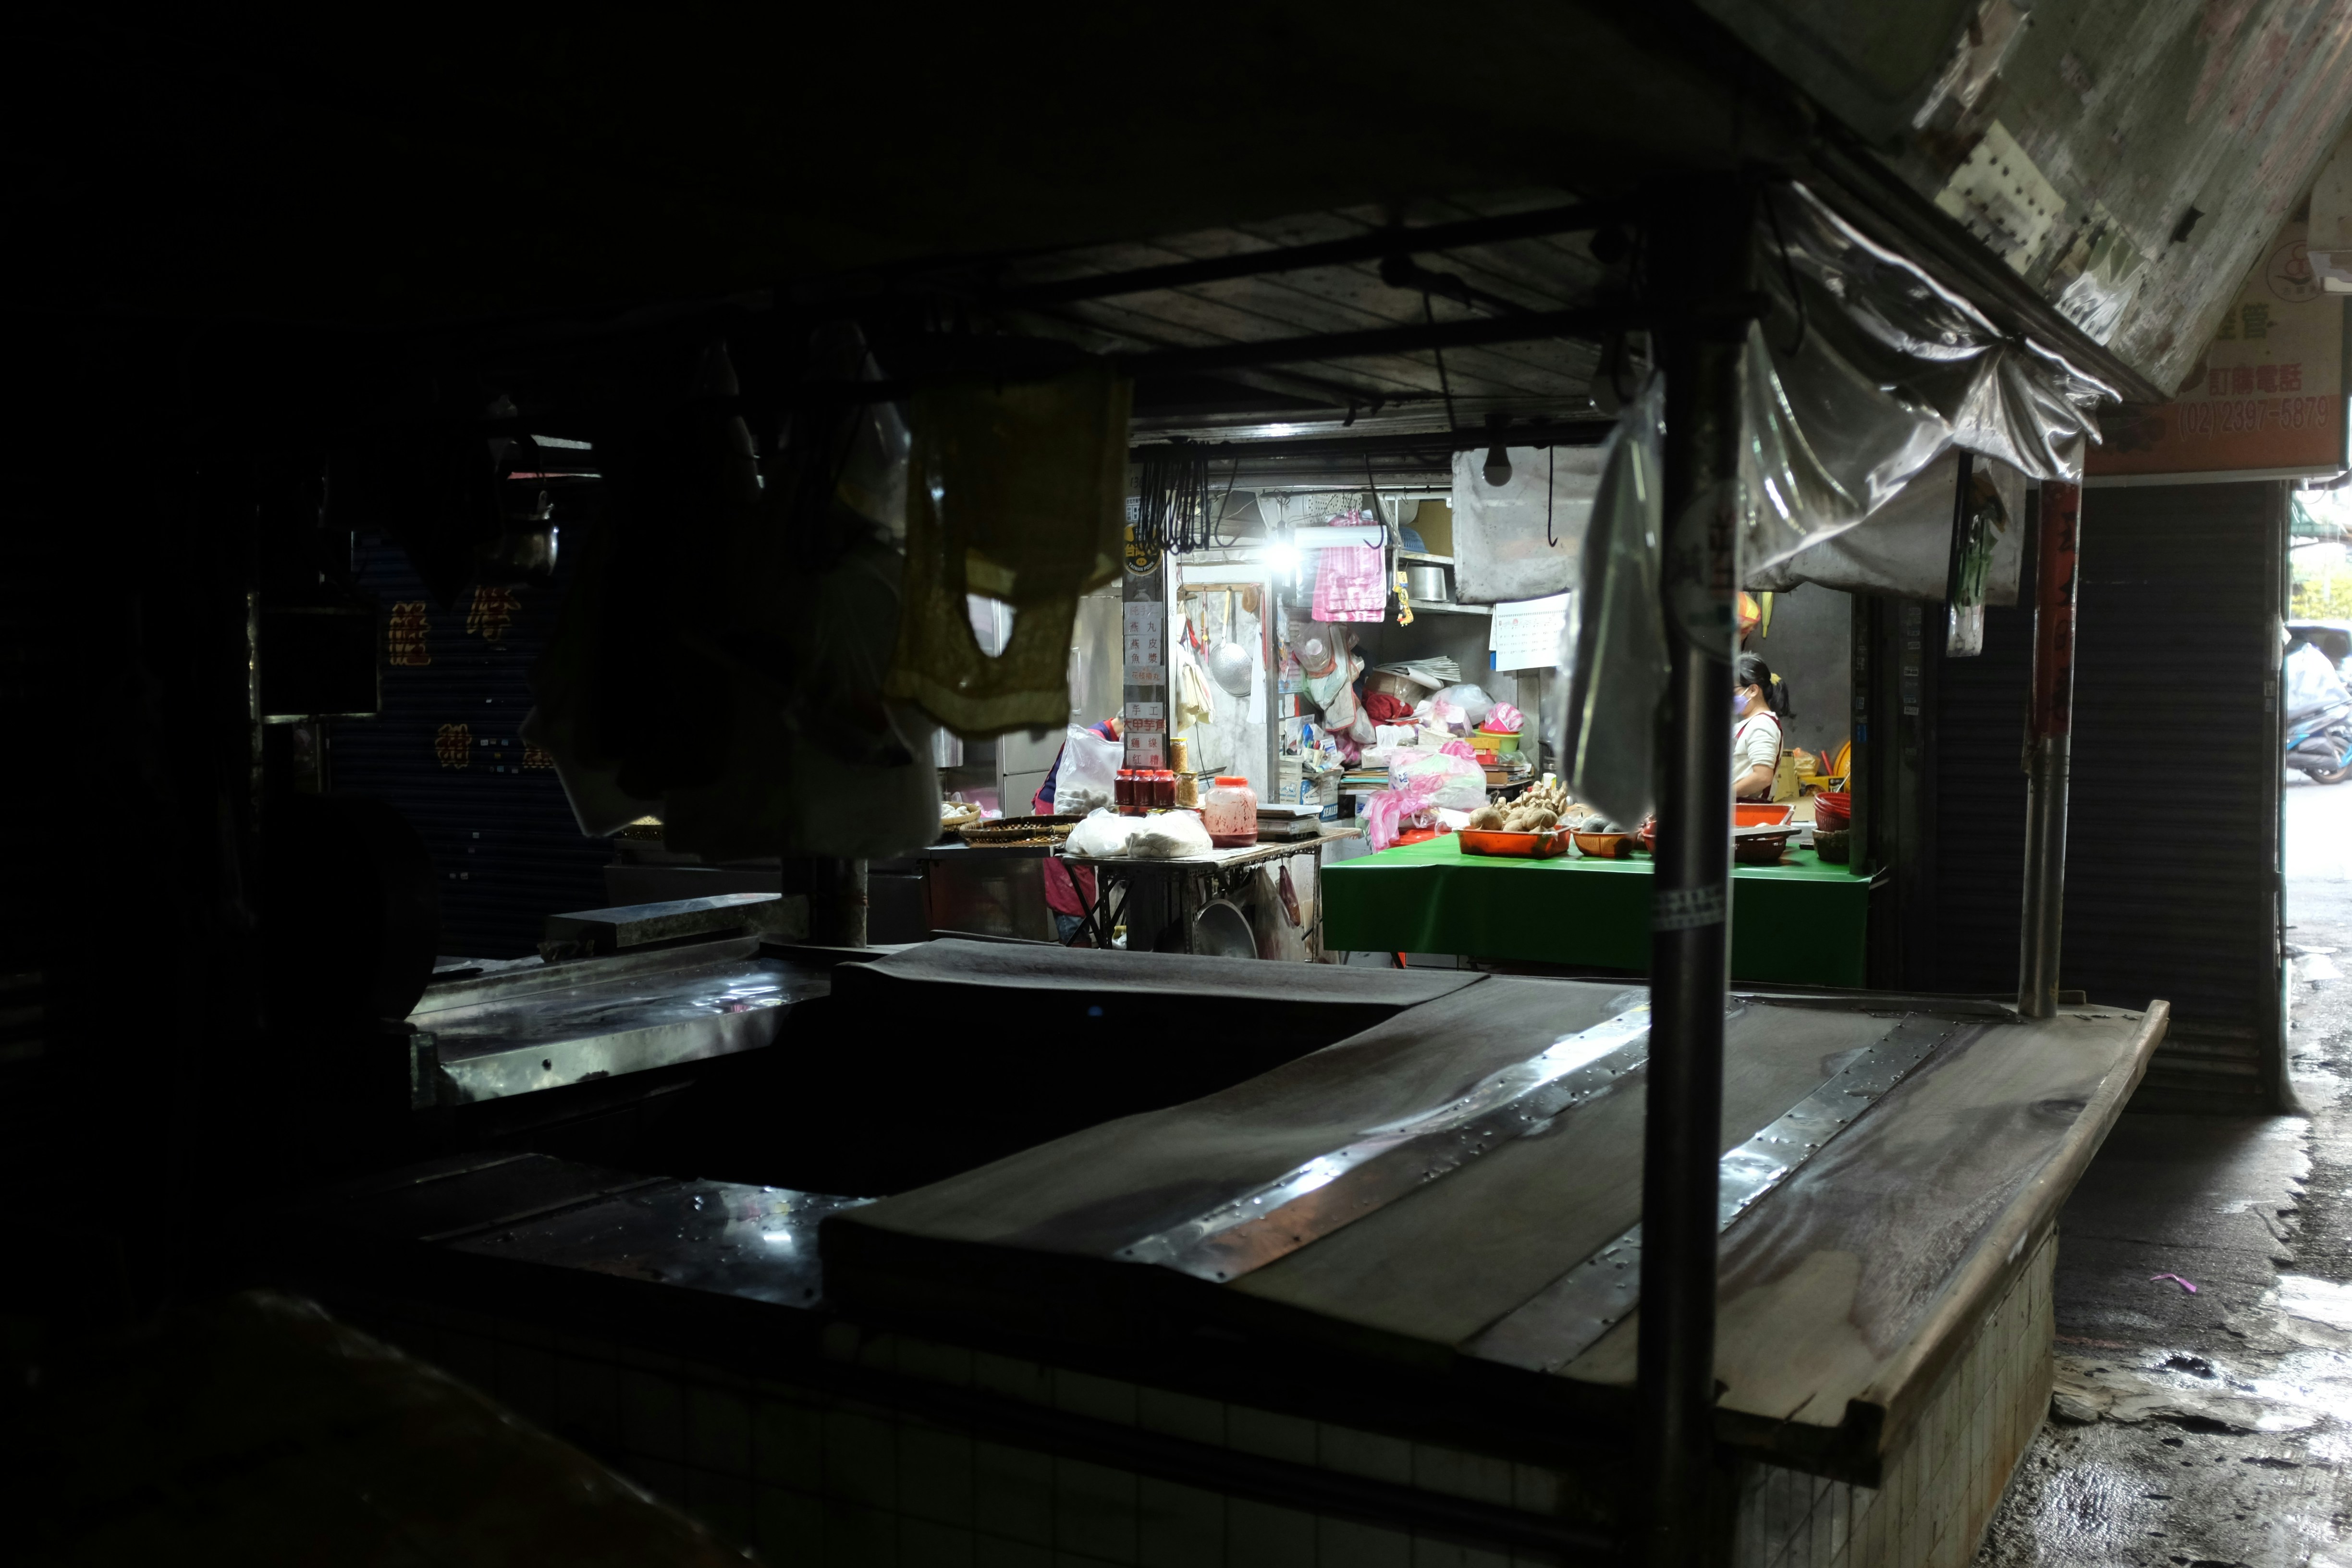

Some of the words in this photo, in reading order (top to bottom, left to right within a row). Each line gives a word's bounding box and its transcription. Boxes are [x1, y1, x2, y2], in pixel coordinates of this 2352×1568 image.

[2209, 363, 2303, 396] 訂購電話
[1128, 562, 1143, 572] TAIWAN
[1143, 561, 1155, 571] PORK
[1130, 605, 1159, 616] 純手工
[1133, 704, 1158, 715] 手工
[1131, 737, 1157, 748] 麵線
